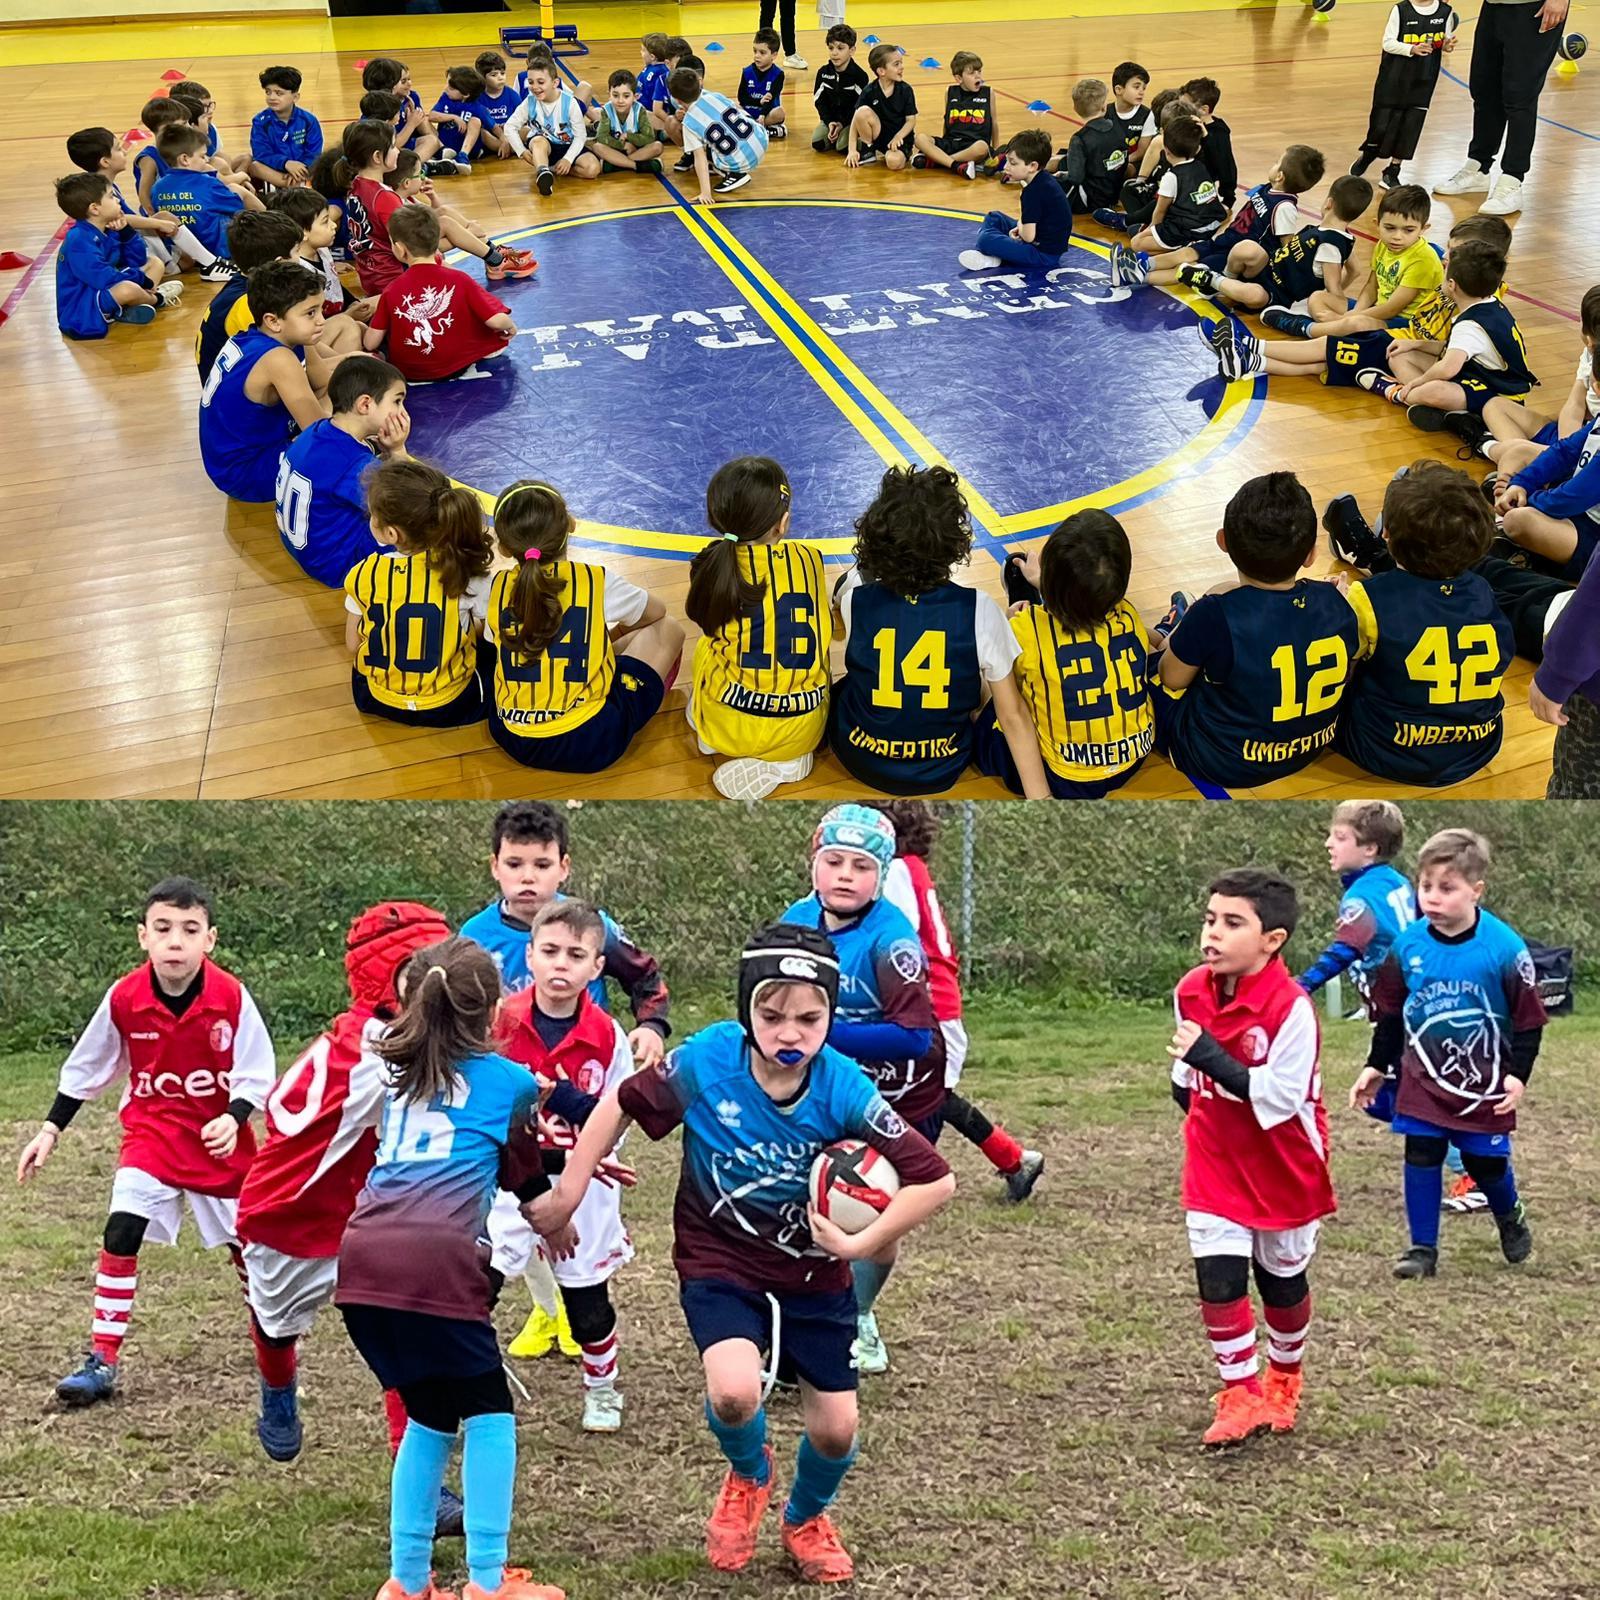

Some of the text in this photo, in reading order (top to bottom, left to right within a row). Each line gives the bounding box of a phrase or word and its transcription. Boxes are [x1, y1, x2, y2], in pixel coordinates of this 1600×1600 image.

[704, 107, 754, 155] 86
[158, 192, 194, 201] CASA DEL
[826, 303, 920, 320] COFFEE
[952, 291, 1011, 305] FOOD
[532, 331, 670, 353] COCKTAIL
[705, 320, 757, 335] BAR
[1335, 340, 1360, 366] 19
[364, 602, 443, 674] 10
[740, 592, 817, 669] 16
[872, 627, 951, 709] 14
[1056, 631, 1148, 721] 23
[1270, 634, 1348, 722] 12
[1404, 623, 1503, 704] 42
